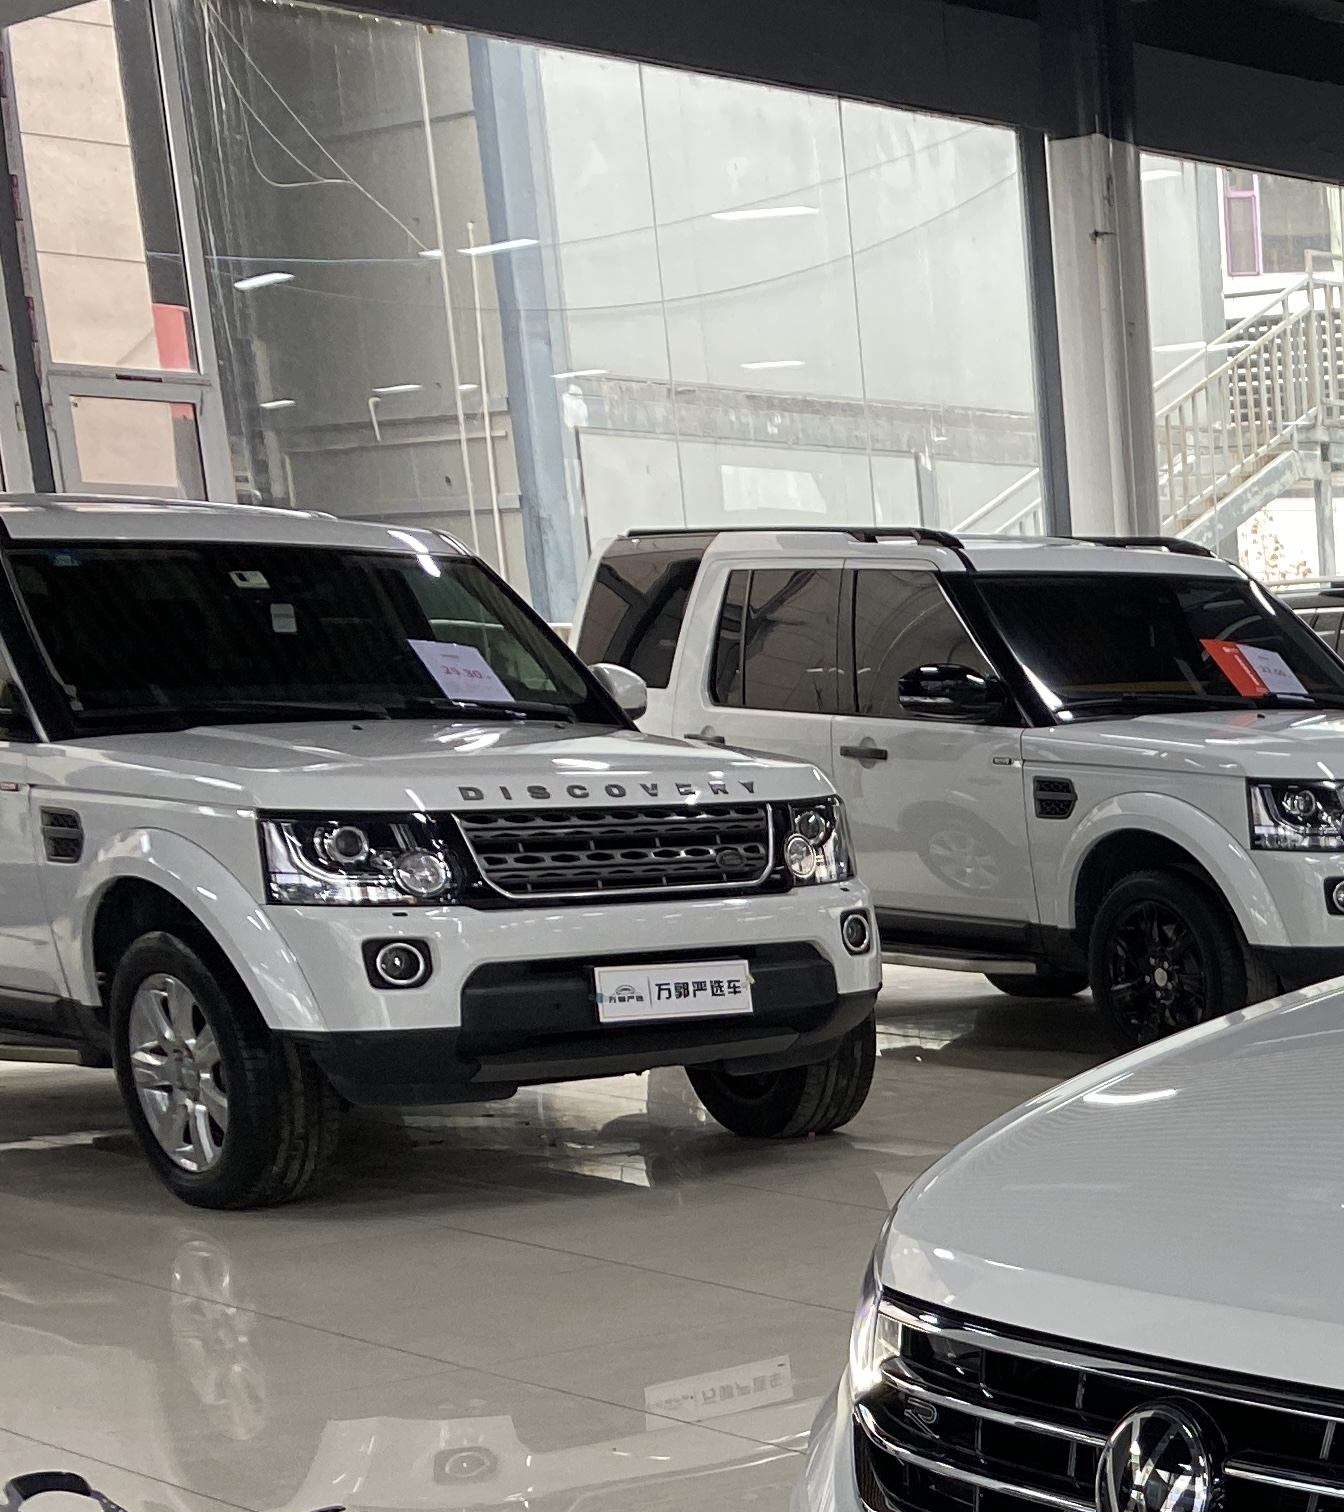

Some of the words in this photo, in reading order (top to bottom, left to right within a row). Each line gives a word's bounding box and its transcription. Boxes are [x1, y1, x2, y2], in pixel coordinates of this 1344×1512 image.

[458, 780, 755, 801] DISCOVERY
[655, 979, 742, 1001] 万郭严选车
